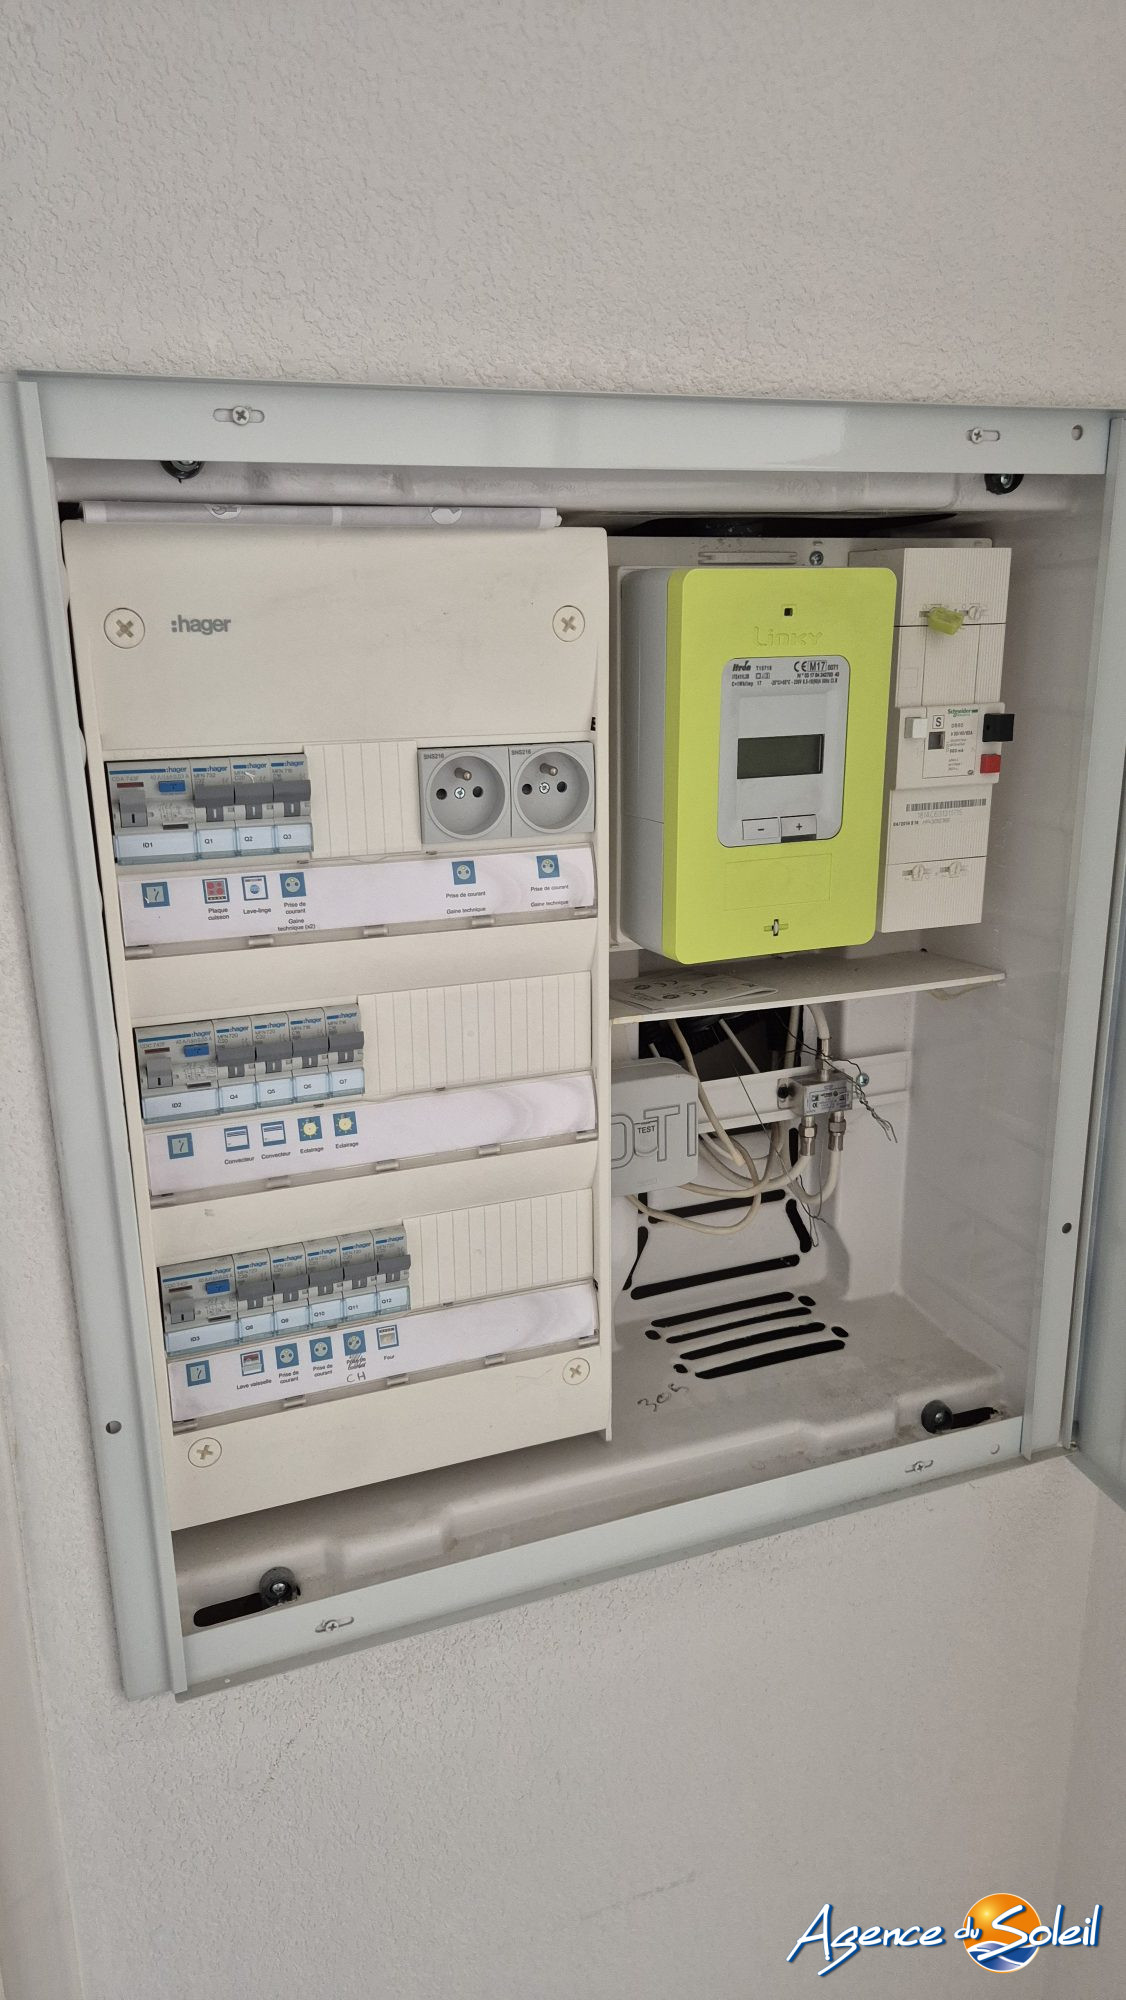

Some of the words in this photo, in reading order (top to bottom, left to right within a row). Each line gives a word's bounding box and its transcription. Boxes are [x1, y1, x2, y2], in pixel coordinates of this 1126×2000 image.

[935, 717, 942, 727] S
[243, 907, 272, 915] Lave-linge
[278, 924, 304, 932] technique
[637, 1125, 655, 1134] TEST
[335, 1141, 359, 1150] Eclairage
[261, 1150, 291, 1160] Convecteur
[300, 1146, 324, 1155] Eclairage
[224, 1156, 255, 1165] Convecteur
[312, 1364, 325, 1372] Prise
[314, 1369, 333, 1378] courant
[250, 1378, 272, 1388] vaisselle
[280, 1376, 299, 1384] courant
